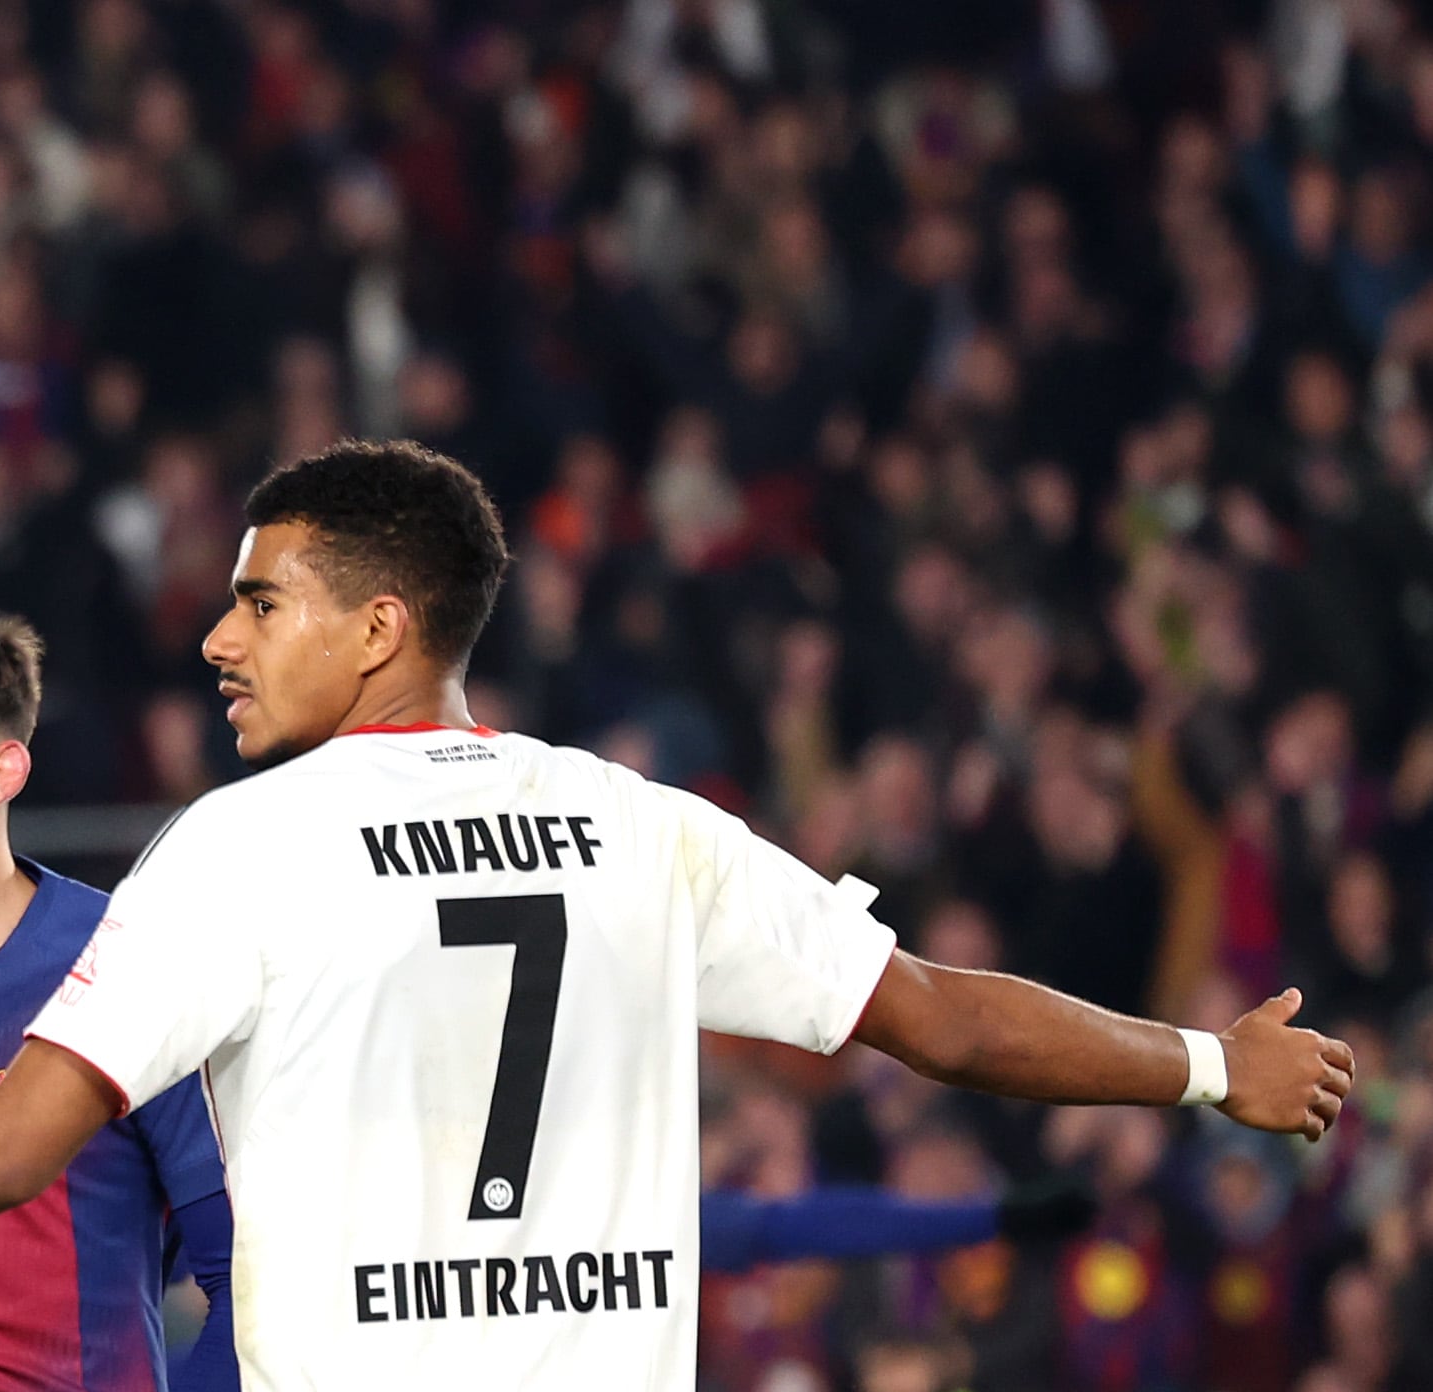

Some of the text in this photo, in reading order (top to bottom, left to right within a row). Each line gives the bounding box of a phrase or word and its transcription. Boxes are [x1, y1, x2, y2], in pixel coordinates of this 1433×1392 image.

[360, 813, 603, 876] KNAUFF
[436, 893, 568, 1221] 7
[354, 1249, 674, 1323] EINTRACHT
